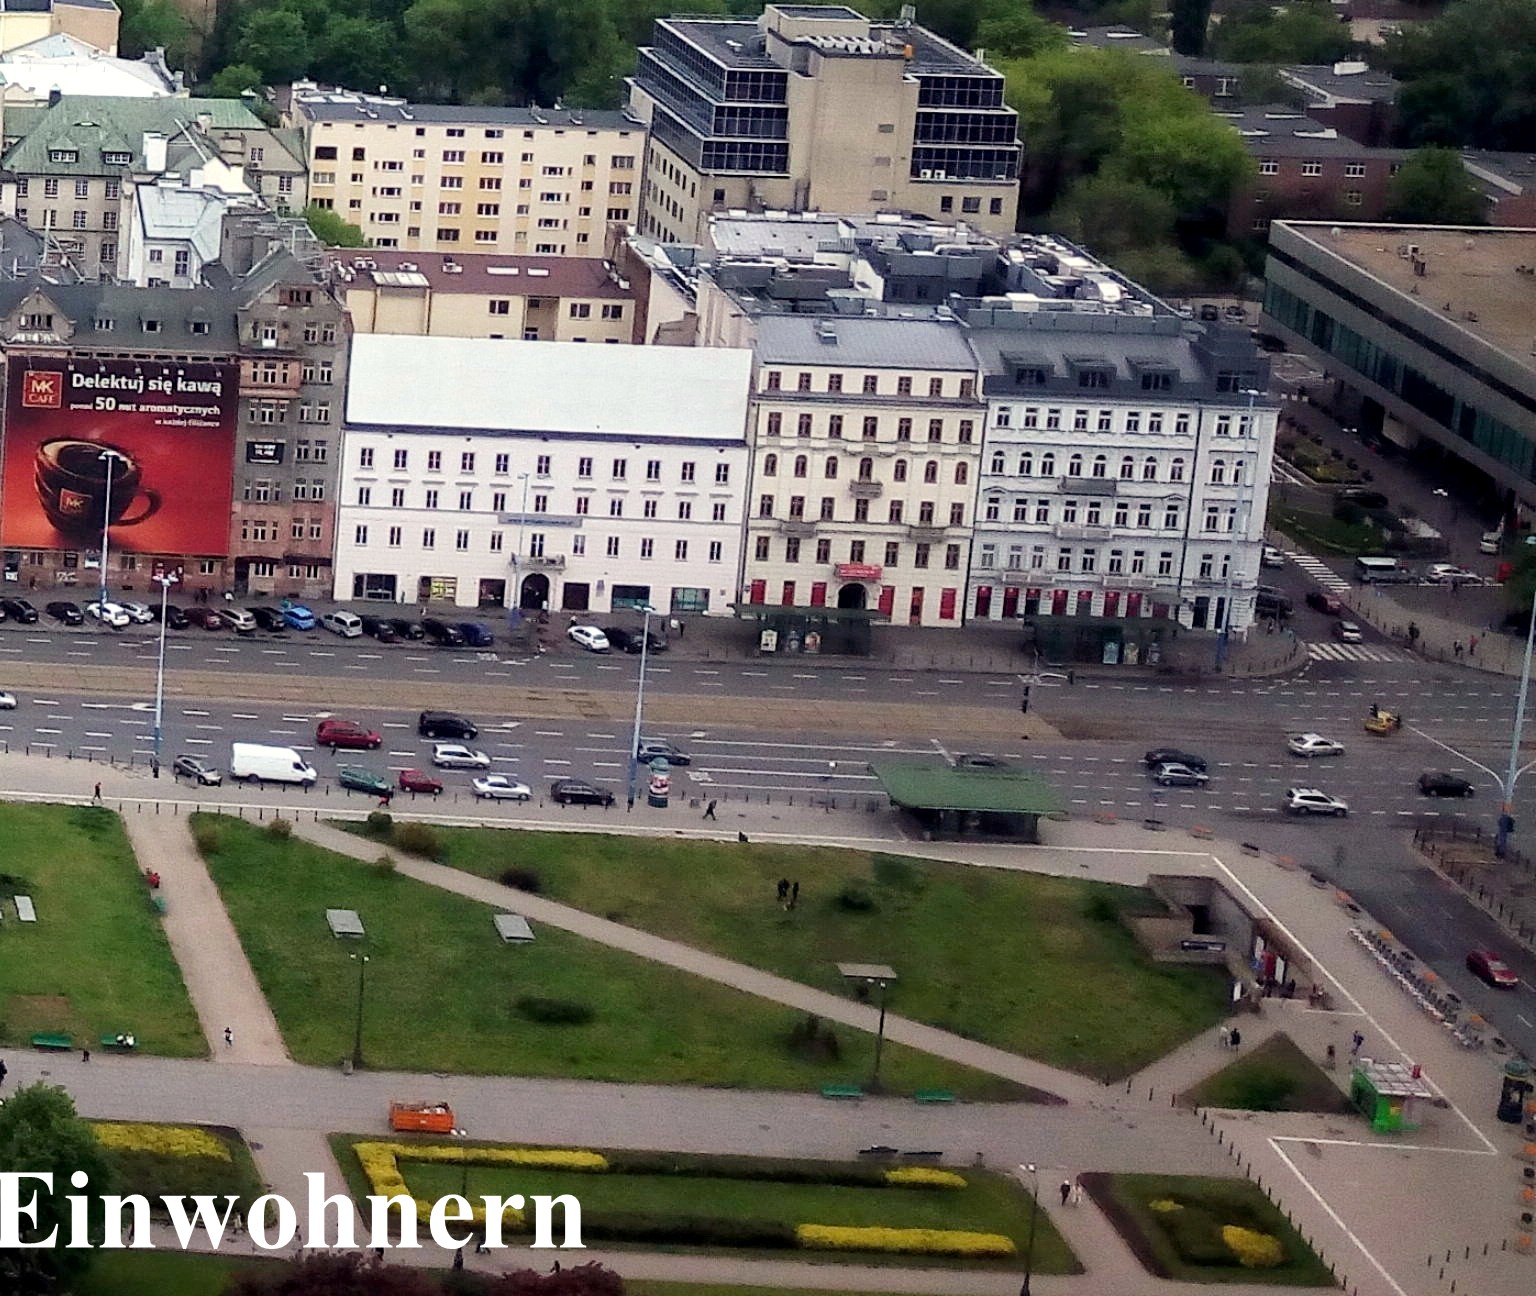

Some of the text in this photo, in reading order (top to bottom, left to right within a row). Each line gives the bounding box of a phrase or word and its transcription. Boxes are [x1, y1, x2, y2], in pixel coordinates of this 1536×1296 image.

[31, 380, 54, 393] MK
[72, 373, 221, 396] Delektuj się kawą
[95, 397, 116, 411] 50
[139, 404, 221, 417] aromatycznych
